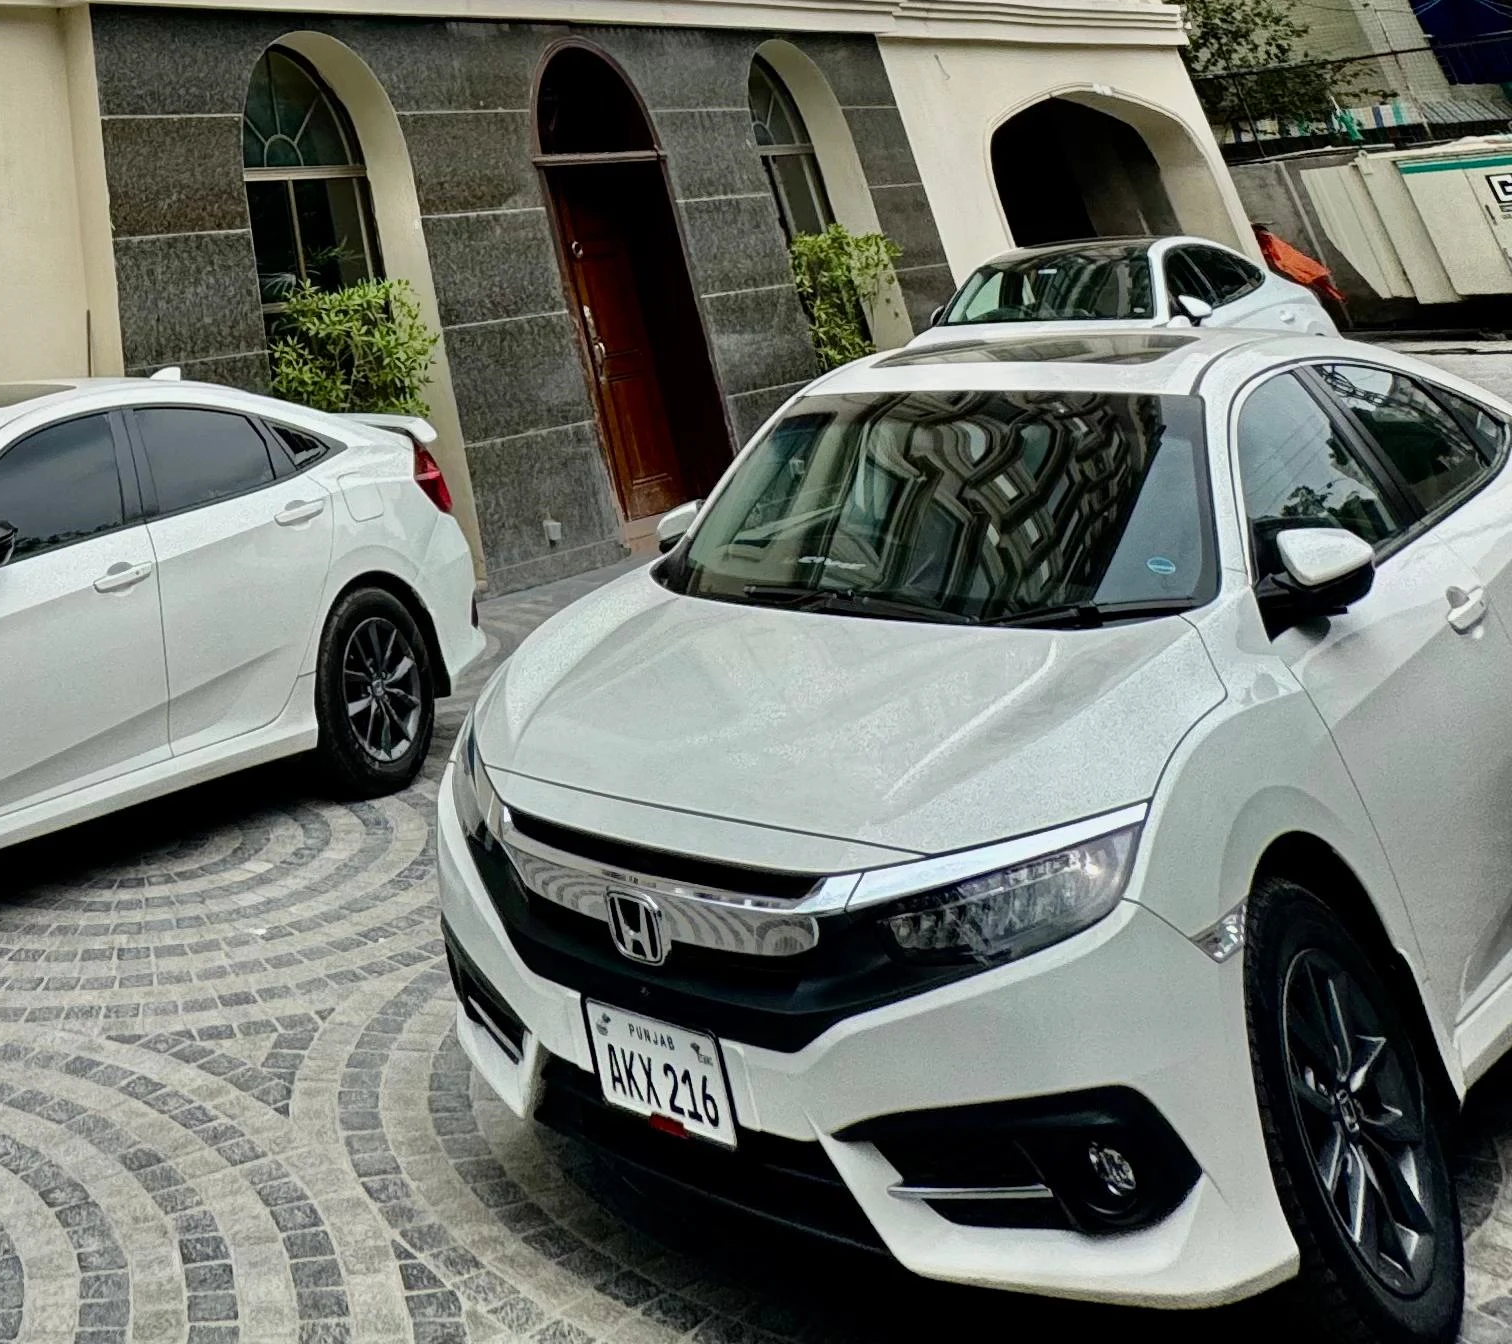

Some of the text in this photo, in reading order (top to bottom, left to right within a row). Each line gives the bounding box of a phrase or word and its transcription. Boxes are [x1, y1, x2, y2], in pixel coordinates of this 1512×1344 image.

[628, 1023, 675, 1051] PUNJAB
[608, 1043, 719, 1128] AKX 216
